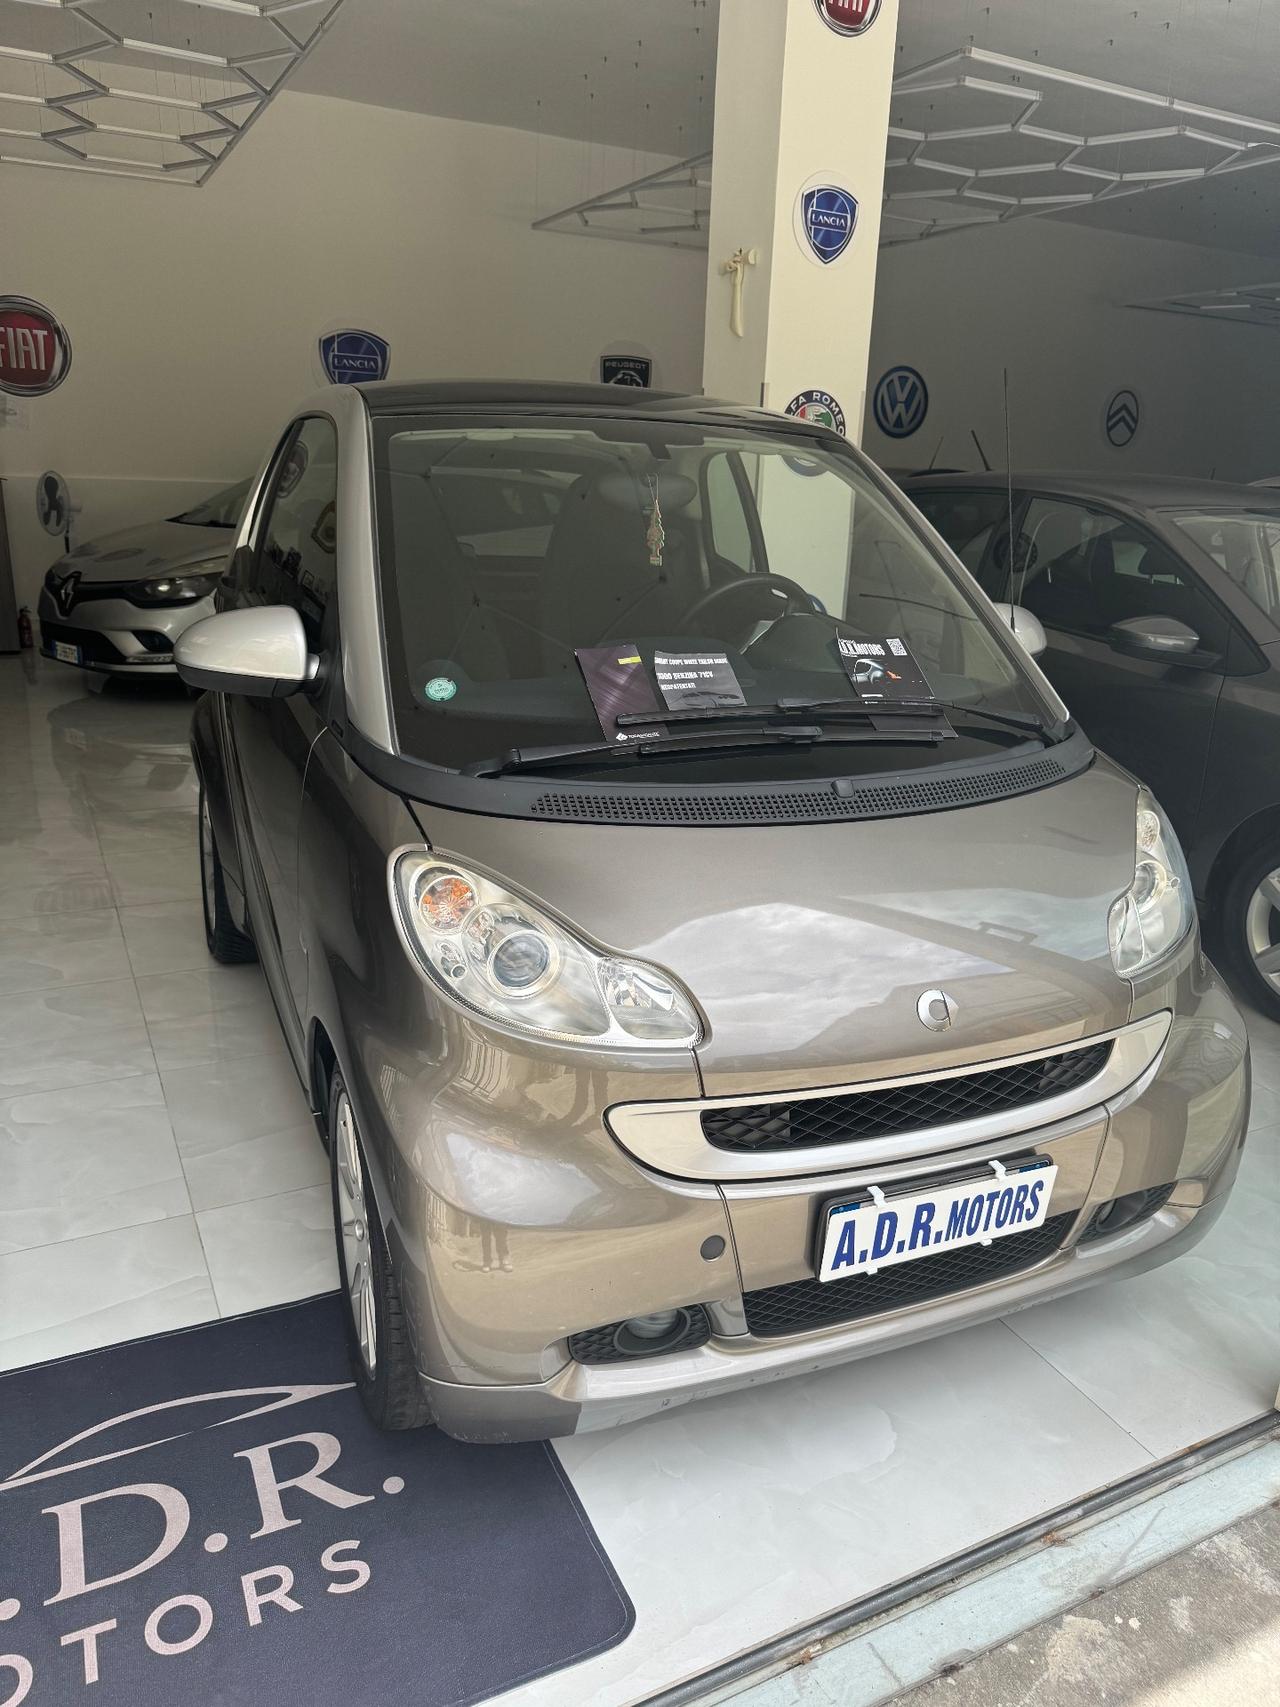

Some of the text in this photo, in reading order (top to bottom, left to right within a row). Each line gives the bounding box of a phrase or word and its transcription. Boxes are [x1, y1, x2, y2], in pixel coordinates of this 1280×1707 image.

[811, 213, 845, 227] LANCIA
[334, 357, 377, 369] LANCIA
[812, 391, 845, 437] ROMEO
